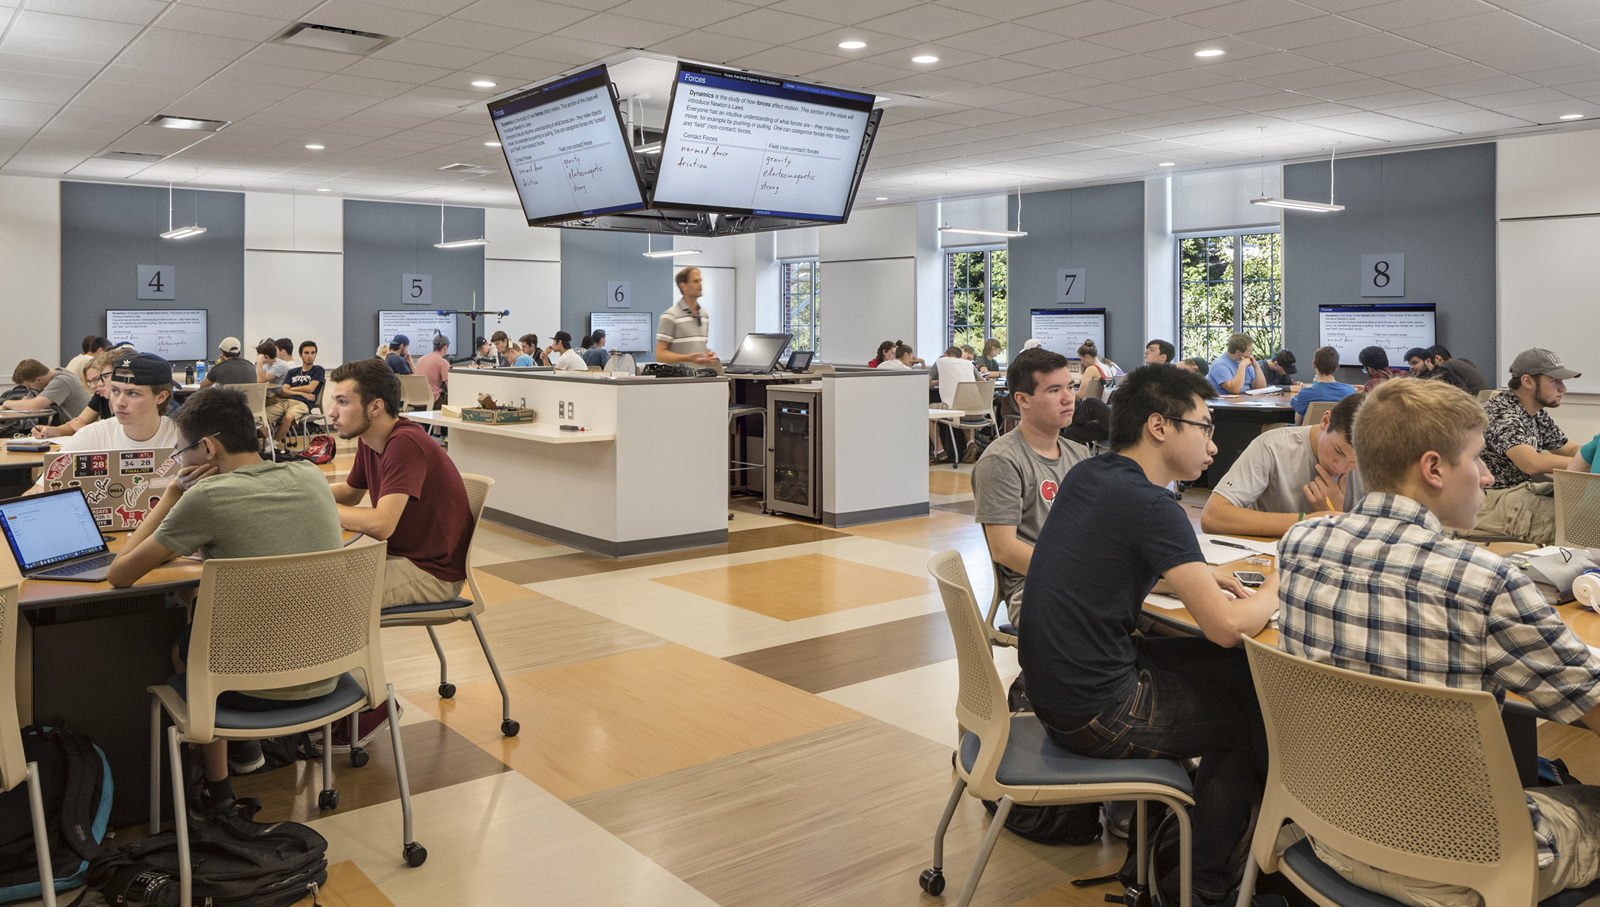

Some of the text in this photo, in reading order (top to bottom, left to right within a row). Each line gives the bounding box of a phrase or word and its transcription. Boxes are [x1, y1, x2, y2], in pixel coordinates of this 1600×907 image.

[685, 73, 706, 84] Forces
[689, 89, 714, 98] Dynamics
[686, 104, 708, 113] Everyone
[743, 114, 774, 124] understanding
[707, 124, 737, 132] (non-contact)
[712, 146, 728, 157] force
[677, 157, 707, 169] friction
[766, 156, 791, 168] gravity
[763, 164, 815, 184] electromagnetic
[760, 181, 779, 194] strong
[148, 271, 164, 292] 4
[1373, 261, 1390, 288] 8
[410, 279, 423, 298] 5
[1065, 275, 1077, 295] 7
[615, 285, 624, 302] 6
